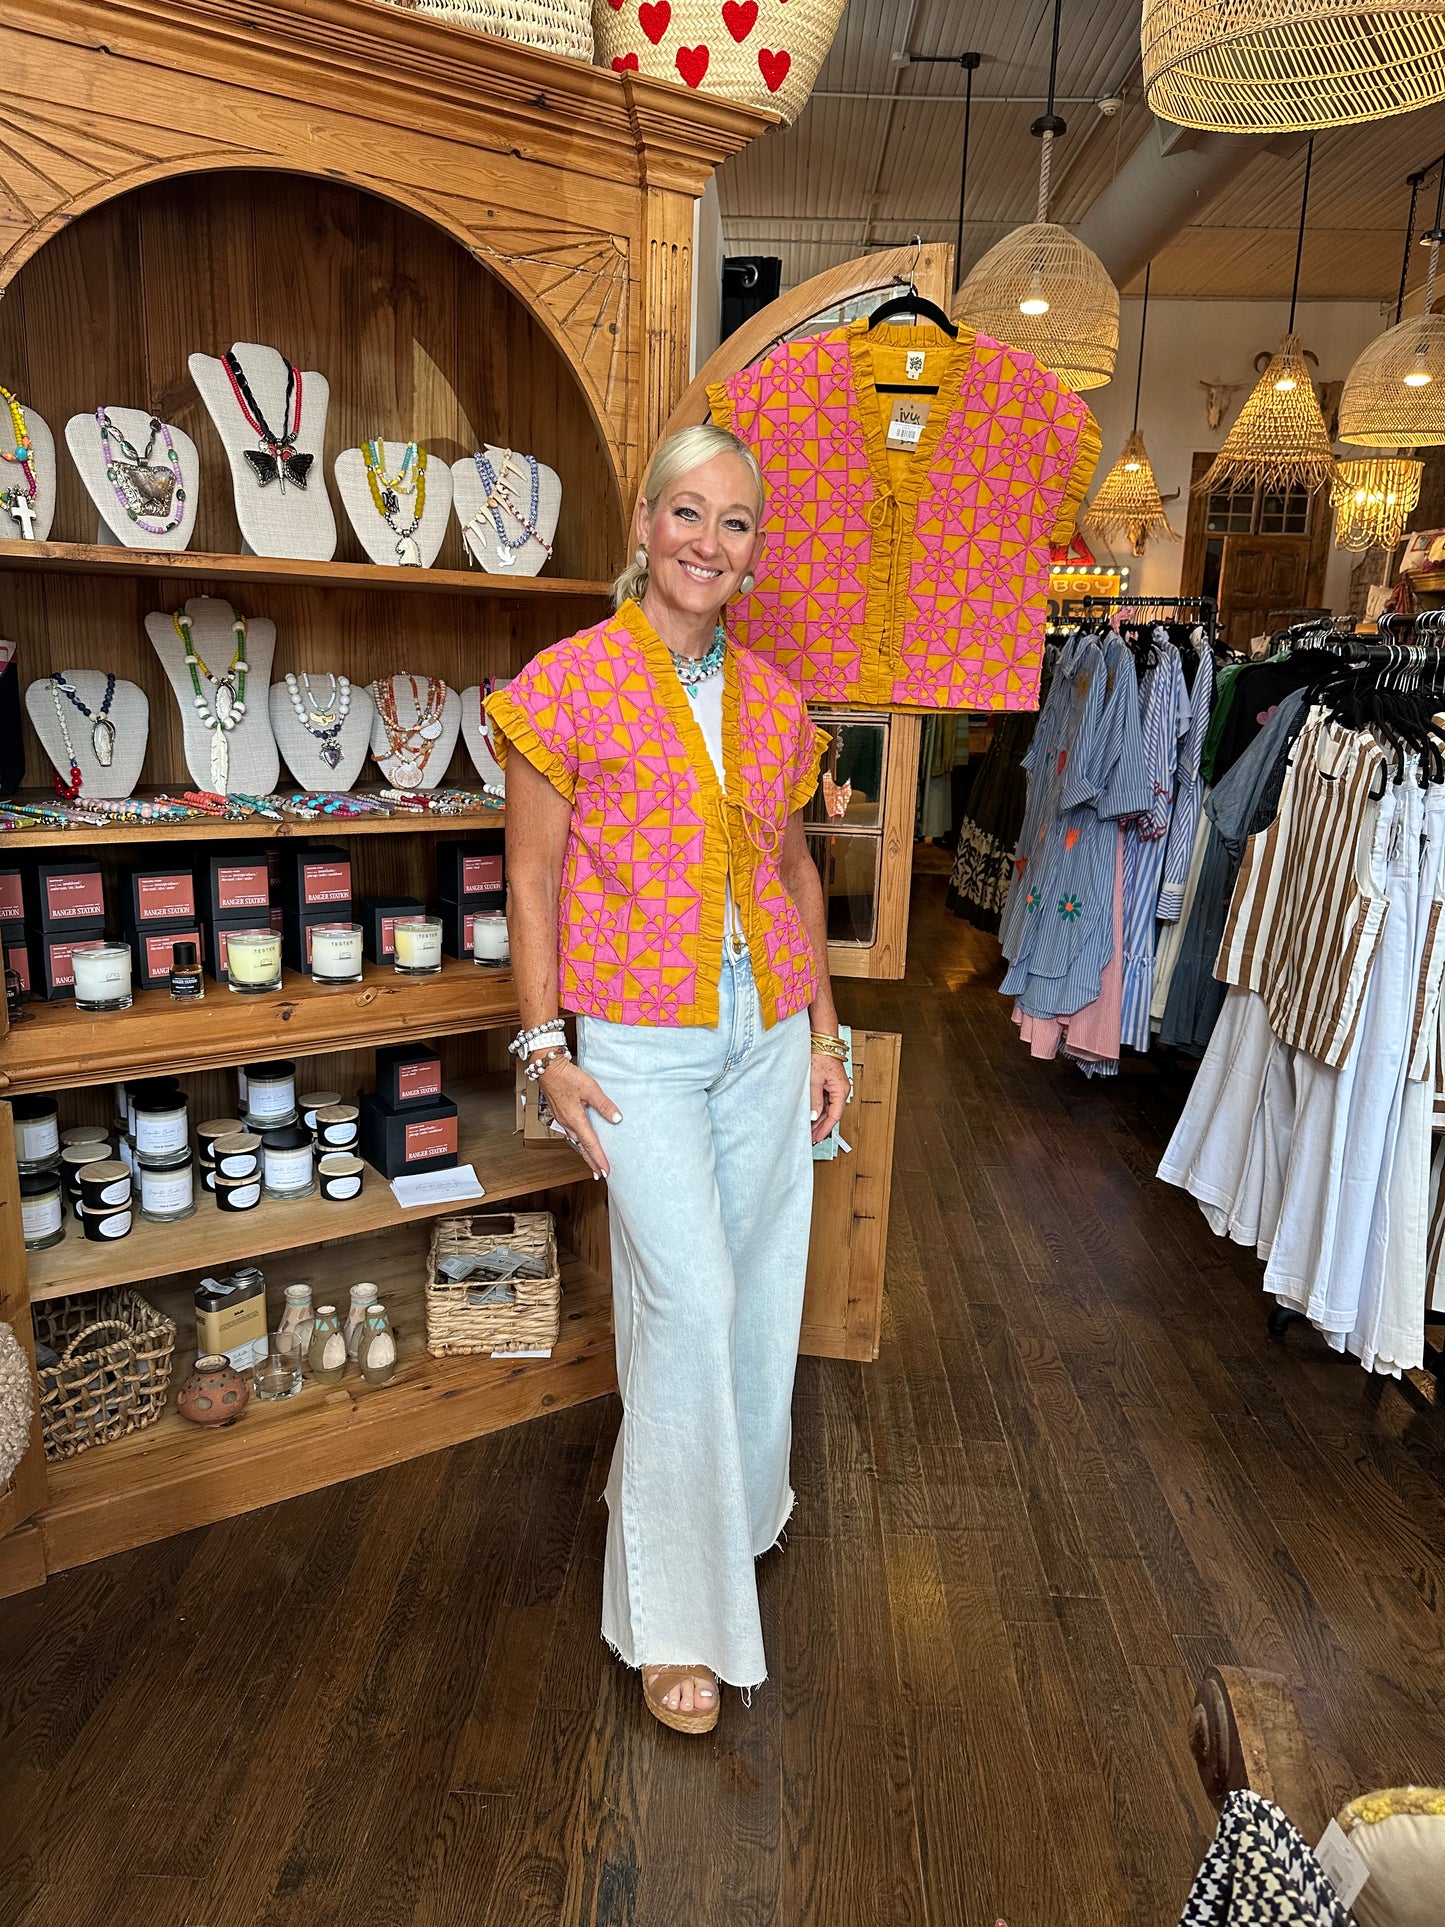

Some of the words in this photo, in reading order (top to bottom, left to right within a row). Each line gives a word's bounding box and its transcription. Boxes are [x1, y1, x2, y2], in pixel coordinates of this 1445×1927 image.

[222, 898, 244, 906] RANGER
[245, 897, 267, 905] STATION
[308, 892, 329, 901] RANGER
[329, 891, 350, 899] STATION
[52, 907, 77, 917] RANGER
[77, 906, 101, 915] STATION
[143, 908, 167, 917] RANGER
[167, 906, 190, 915] STATION
[253, 946, 276, 954] TESTER
[401, 1087, 420, 1098] RANGER
[420, 1087, 438, 1095] STATION
[408, 1149, 428, 1159] RANGER
[428, 1147, 448, 1156] STATION
